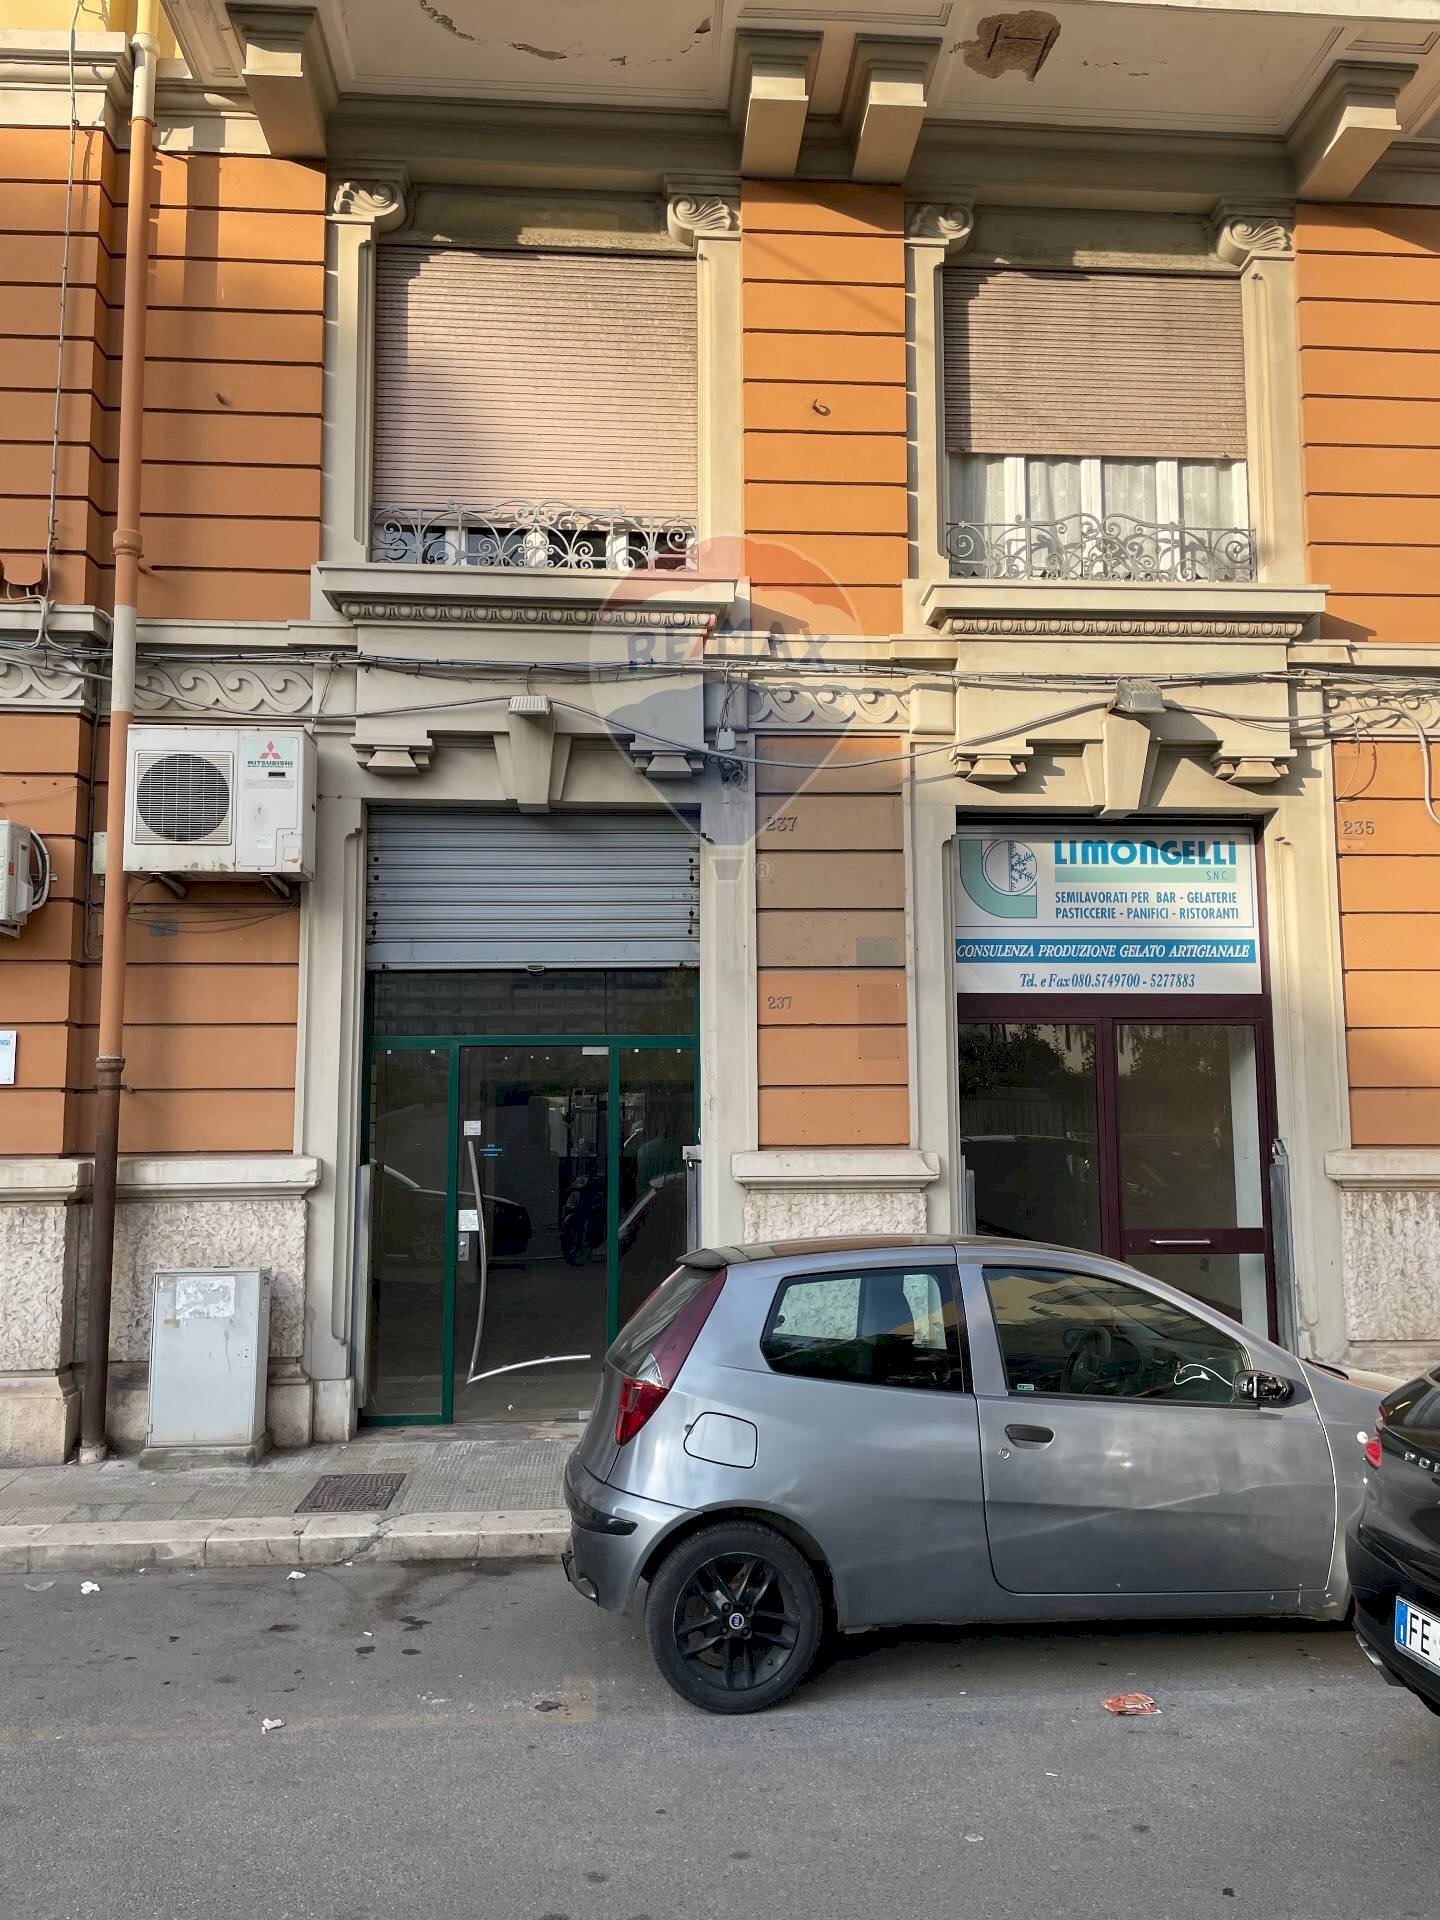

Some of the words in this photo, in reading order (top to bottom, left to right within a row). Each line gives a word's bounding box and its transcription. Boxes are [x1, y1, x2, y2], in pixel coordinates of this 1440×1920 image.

[766, 817, 798, 832] 237
[1343, 820, 1375, 836] 235
[1054, 839, 1237, 866] LIMONGELLI
[1055, 891, 1128, 904] SEMILAVORATI
[1131, 891, 1150, 903] PER
[1156, 891, 1177, 903] BAR
[1187, 891, 1237, 903] GELATERIE
[1055, 907, 1116, 919] PASTICCERIE
[1127, 907, 1169, 920] PANIFICI
[1179, 907, 1239, 919] RISTORANTI
[957, 944, 1034, 957] CONSULENZA
[1038, 944, 1116, 958] PRODUZIONE
[1120, 944, 1166, 958] GELATO
[1168, 944, 1250, 958] ARTIGIANALE
[1020, 973, 1037, 987] Tel.
[1040, 978, 1047, 987] e
[1048, 973, 1071, 987] Fax
[1071, 973, 1140, 988] 080.5749700
[1150, 973, 1195, 988] 5277883
[767, 996, 792, 1010] 237
